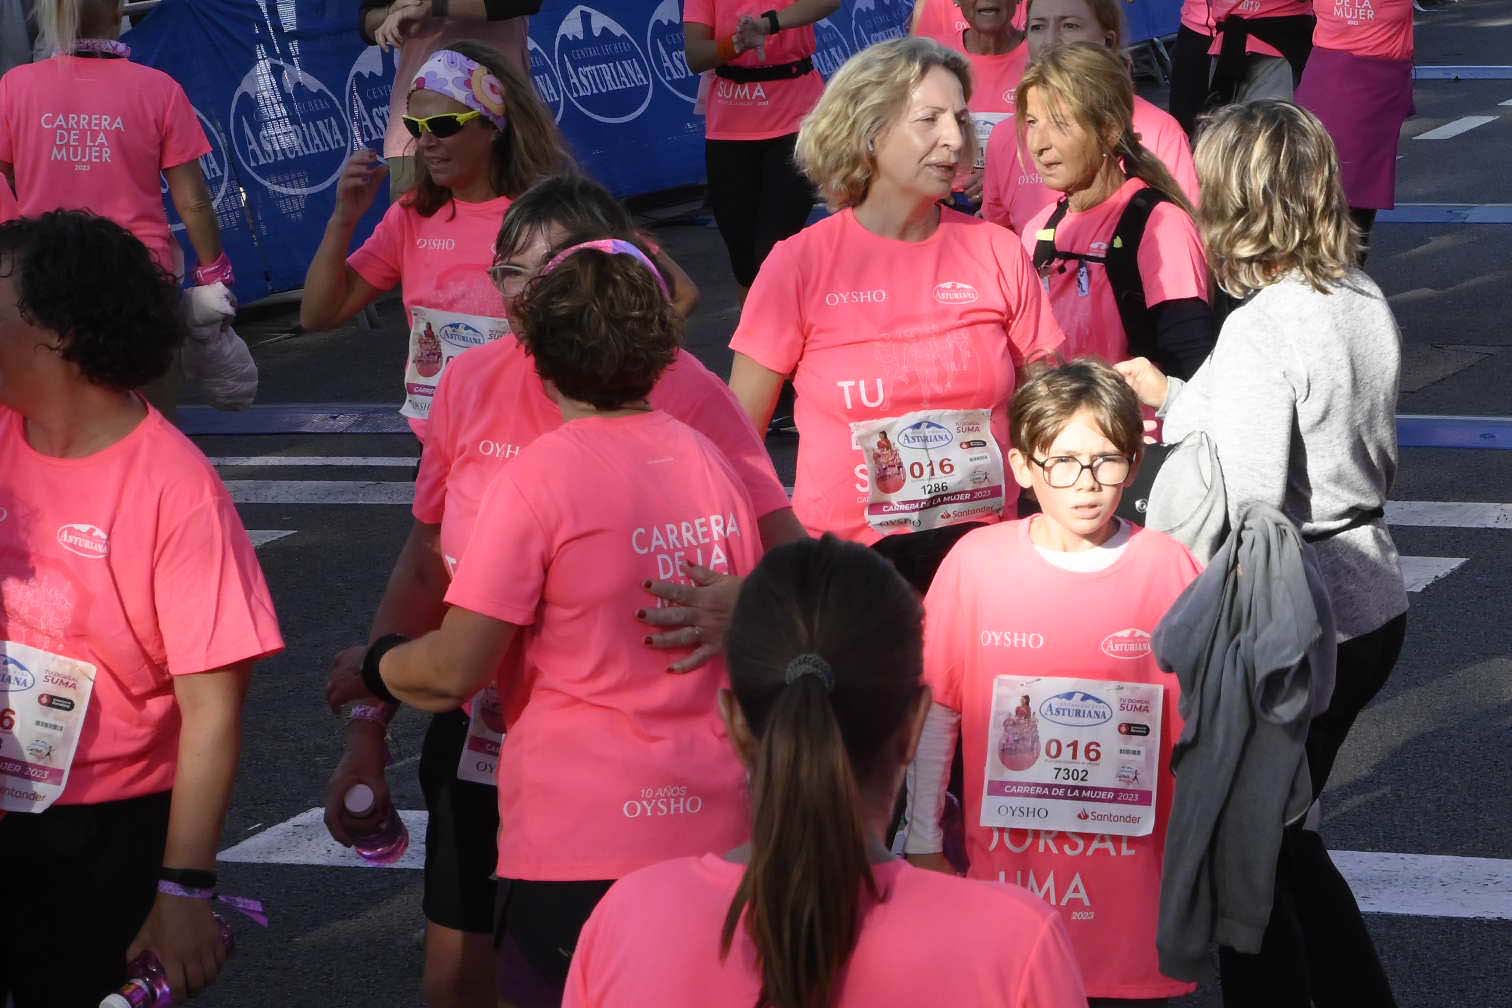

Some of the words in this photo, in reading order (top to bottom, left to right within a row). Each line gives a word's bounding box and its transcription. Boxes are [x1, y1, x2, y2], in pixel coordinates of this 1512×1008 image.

[1333, 6, 1376, 21] MUJER
[563, 52, 649, 98] ASTURIANA
[718, 82, 766, 100] SUMA
[40, 111, 126, 132] CARRERA
[55, 131, 79, 147] DE
[82, 130, 108, 147] LA
[50, 146, 112, 164] MUJER
[824, 289, 887, 307] OYSHO
[837, 378, 885, 410] TU
[909, 457, 955, 480] 016
[921, 481, 949, 495] 1286
[952, 505, 995, 519] Santander
[631, 512, 741, 555] CARRERA
[980, 629, 1045, 649] OYSHO
[43, 674, 78, 690] SUMA
[1044, 702, 1107, 721] ASTURIANA
[1119, 703, 1150, 713] SUMA
[1044, 737, 1102, 762] 016
[1053, 766, 1089, 782] 7302
[640, 785, 654, 798] 10
[655, 785, 687, 798] AÑOS
[1004, 784, 1050, 796] CARRERA
[1051, 786, 1066, 797] DE
[1066, 788, 1080, 798] LA
[1081, 789, 1115, 800] MUJER
[1117, 791, 1139, 802] 2023
[623, 795, 704, 818] OYSHO
[997, 804, 1049, 820] OYSHO
[1090, 810, 1142, 825] Santander
